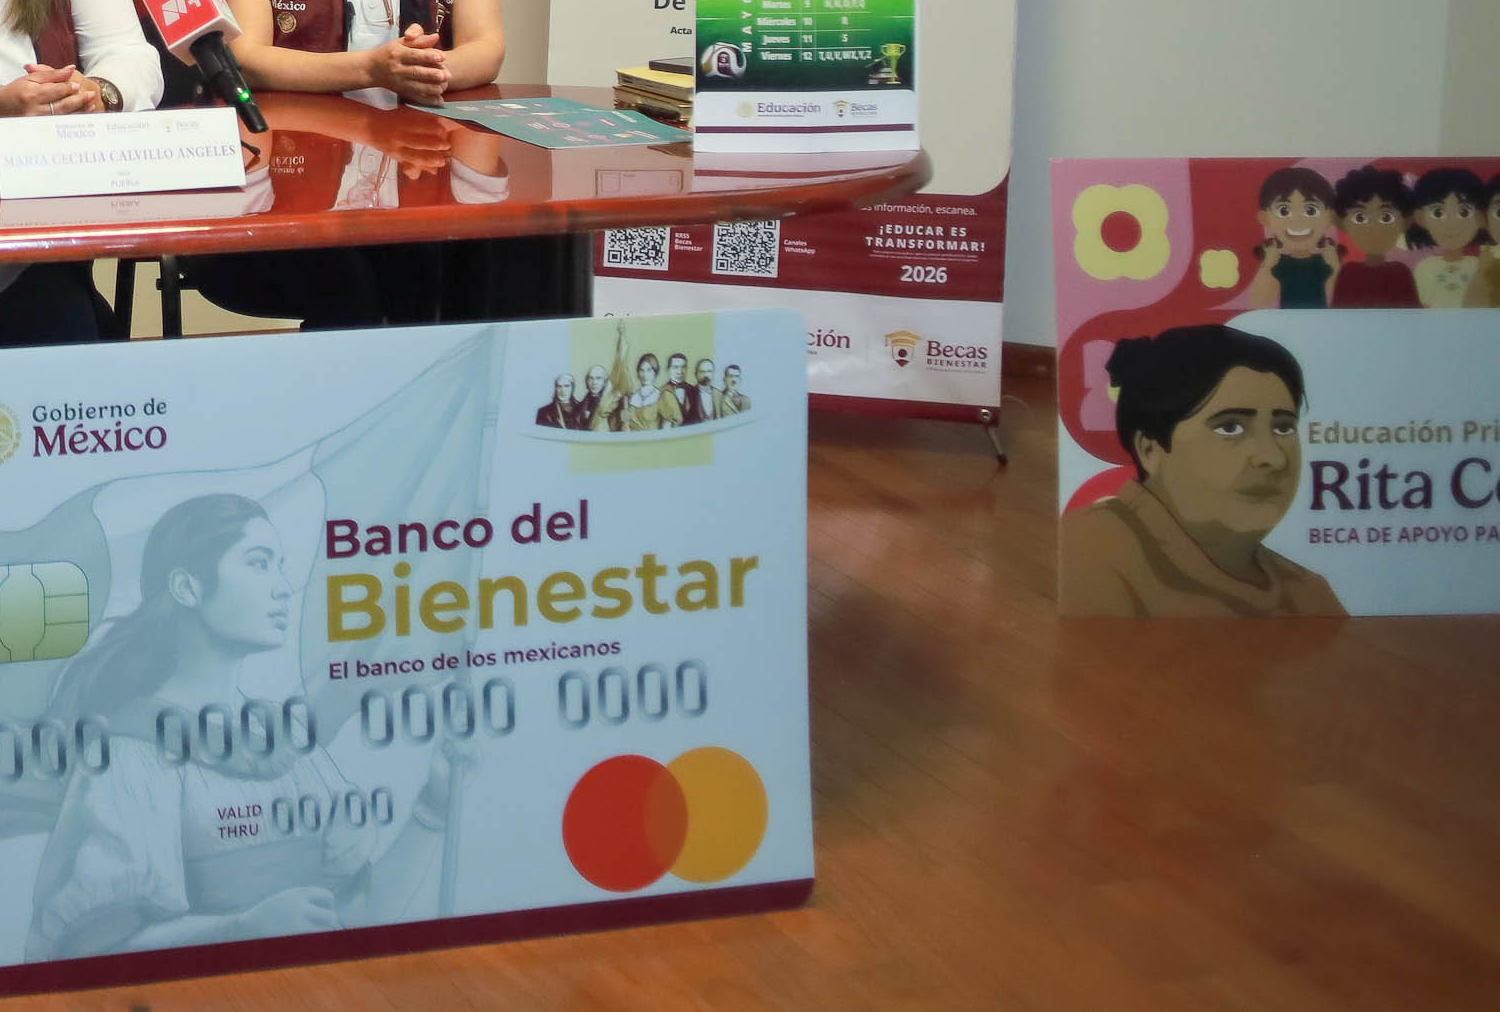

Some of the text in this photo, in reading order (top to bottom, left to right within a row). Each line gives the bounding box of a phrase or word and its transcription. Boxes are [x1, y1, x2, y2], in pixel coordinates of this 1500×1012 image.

[670, 26, 692, 35] Acta
[803, 51, 813, 61] 12
[757, 102, 821, 113] Educación
[51, 149, 106, 166] CECILIA
[109, 147, 173, 162] CALVILLO
[177, 144, 237, 159] ANGELES
[880, 224, 967, 237] ¡EDUCAR ES
[674, 244, 704, 252] Bienestar
[783, 239, 808, 247] Canales
[784, 246, 816, 255] WhatsApp
[865, 236, 985, 252] TRANSFORMAR!
[900, 265, 948, 284] 2026
[927, 340, 987, 360] Becas
[927, 359, 987, 368] BIENESTAR
[32, 398, 167, 423] Gobierno de
[33, 420, 167, 457] México
[1308, 420, 1452, 444] Educación
[1310, 457, 1433, 511] Rita
[325, 499, 589, 559] Banco del
[1309, 525, 1468, 544] BECA DE APOYO
[326, 554, 759, 643] Bienestar
[329, 639, 621, 680] El banco de los mexicanos
[155, 695, 318, 767] 0000
[360, 676, 516, 748] 0000
[557, 659, 708, 730] 0000
[217, 787, 394, 838] VALID 00/00
[217, 823, 259, 840] THRU
